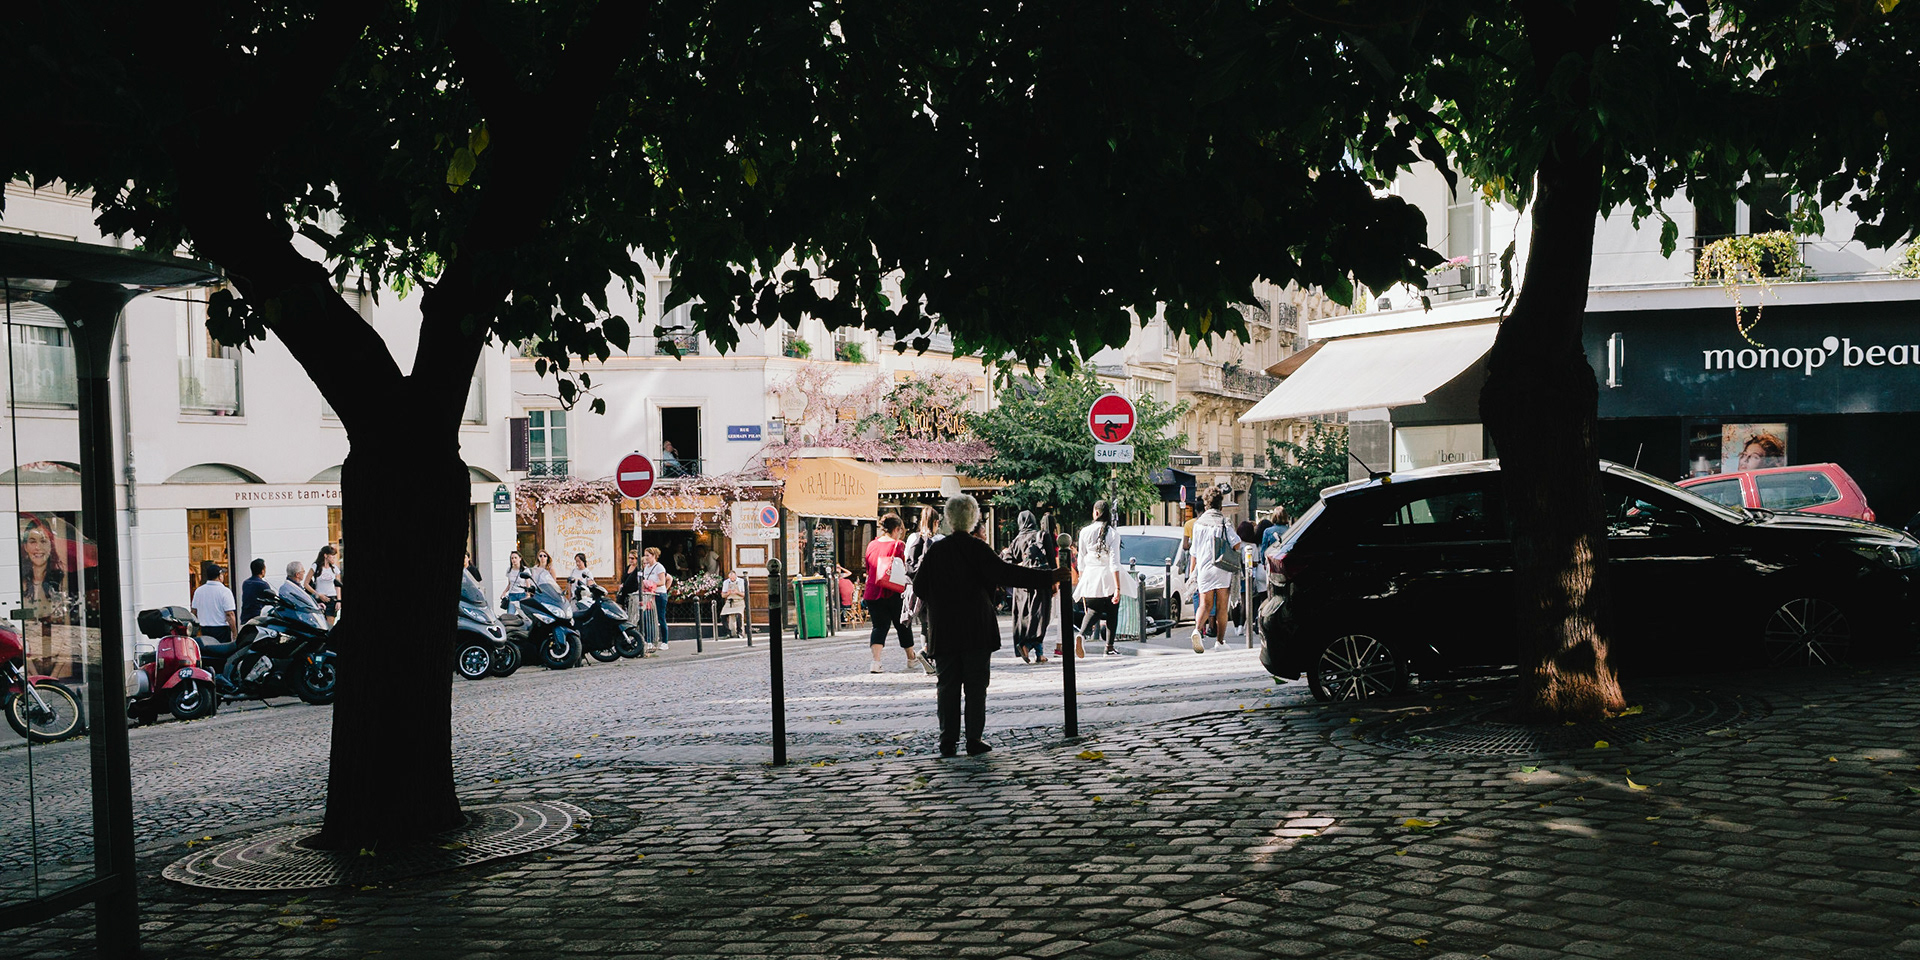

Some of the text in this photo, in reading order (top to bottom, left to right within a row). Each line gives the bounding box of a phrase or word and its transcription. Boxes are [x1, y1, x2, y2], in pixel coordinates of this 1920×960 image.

[1097, 449, 1117, 457] SAUF
[799, 472, 865, 495] VRAI PARIS
[235, 491, 293, 501] PRINCESSE
